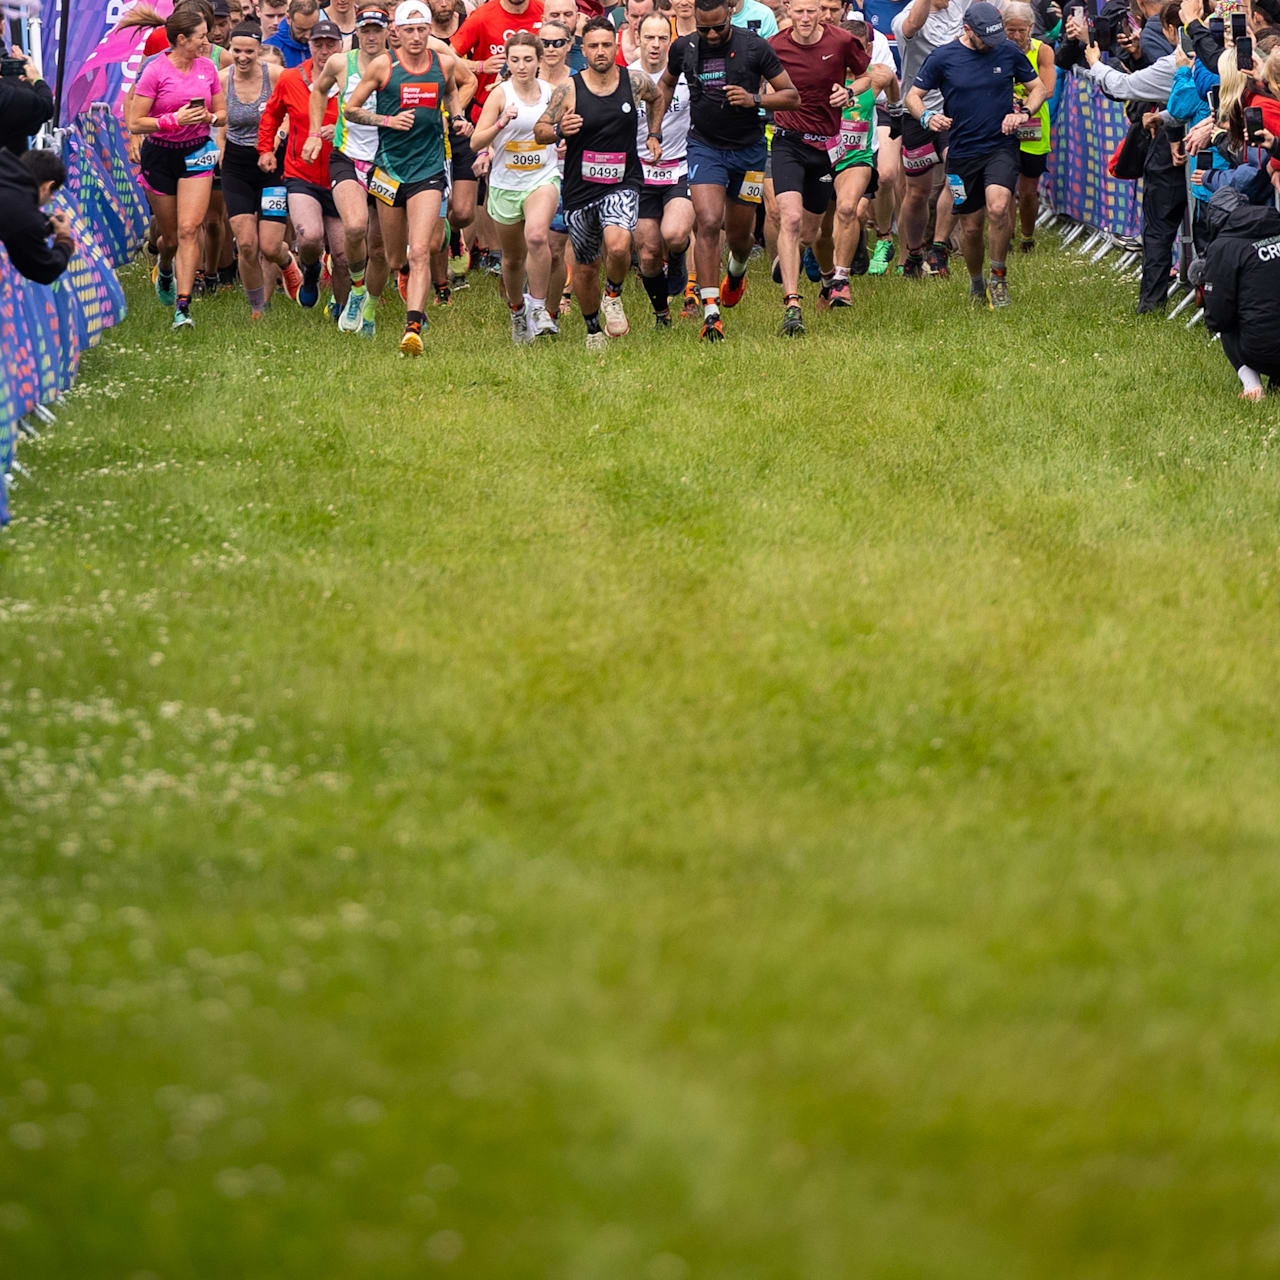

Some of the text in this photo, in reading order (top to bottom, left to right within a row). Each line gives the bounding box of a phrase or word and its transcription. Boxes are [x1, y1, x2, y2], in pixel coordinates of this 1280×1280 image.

[403, 86, 420, 94] Army
[194, 153, 217, 166] 2491
[512, 154, 541, 166] 3099
[589, 166, 619, 178] 0493
[646, 169, 673, 180] 1493
[370, 180, 396, 200] 3074
